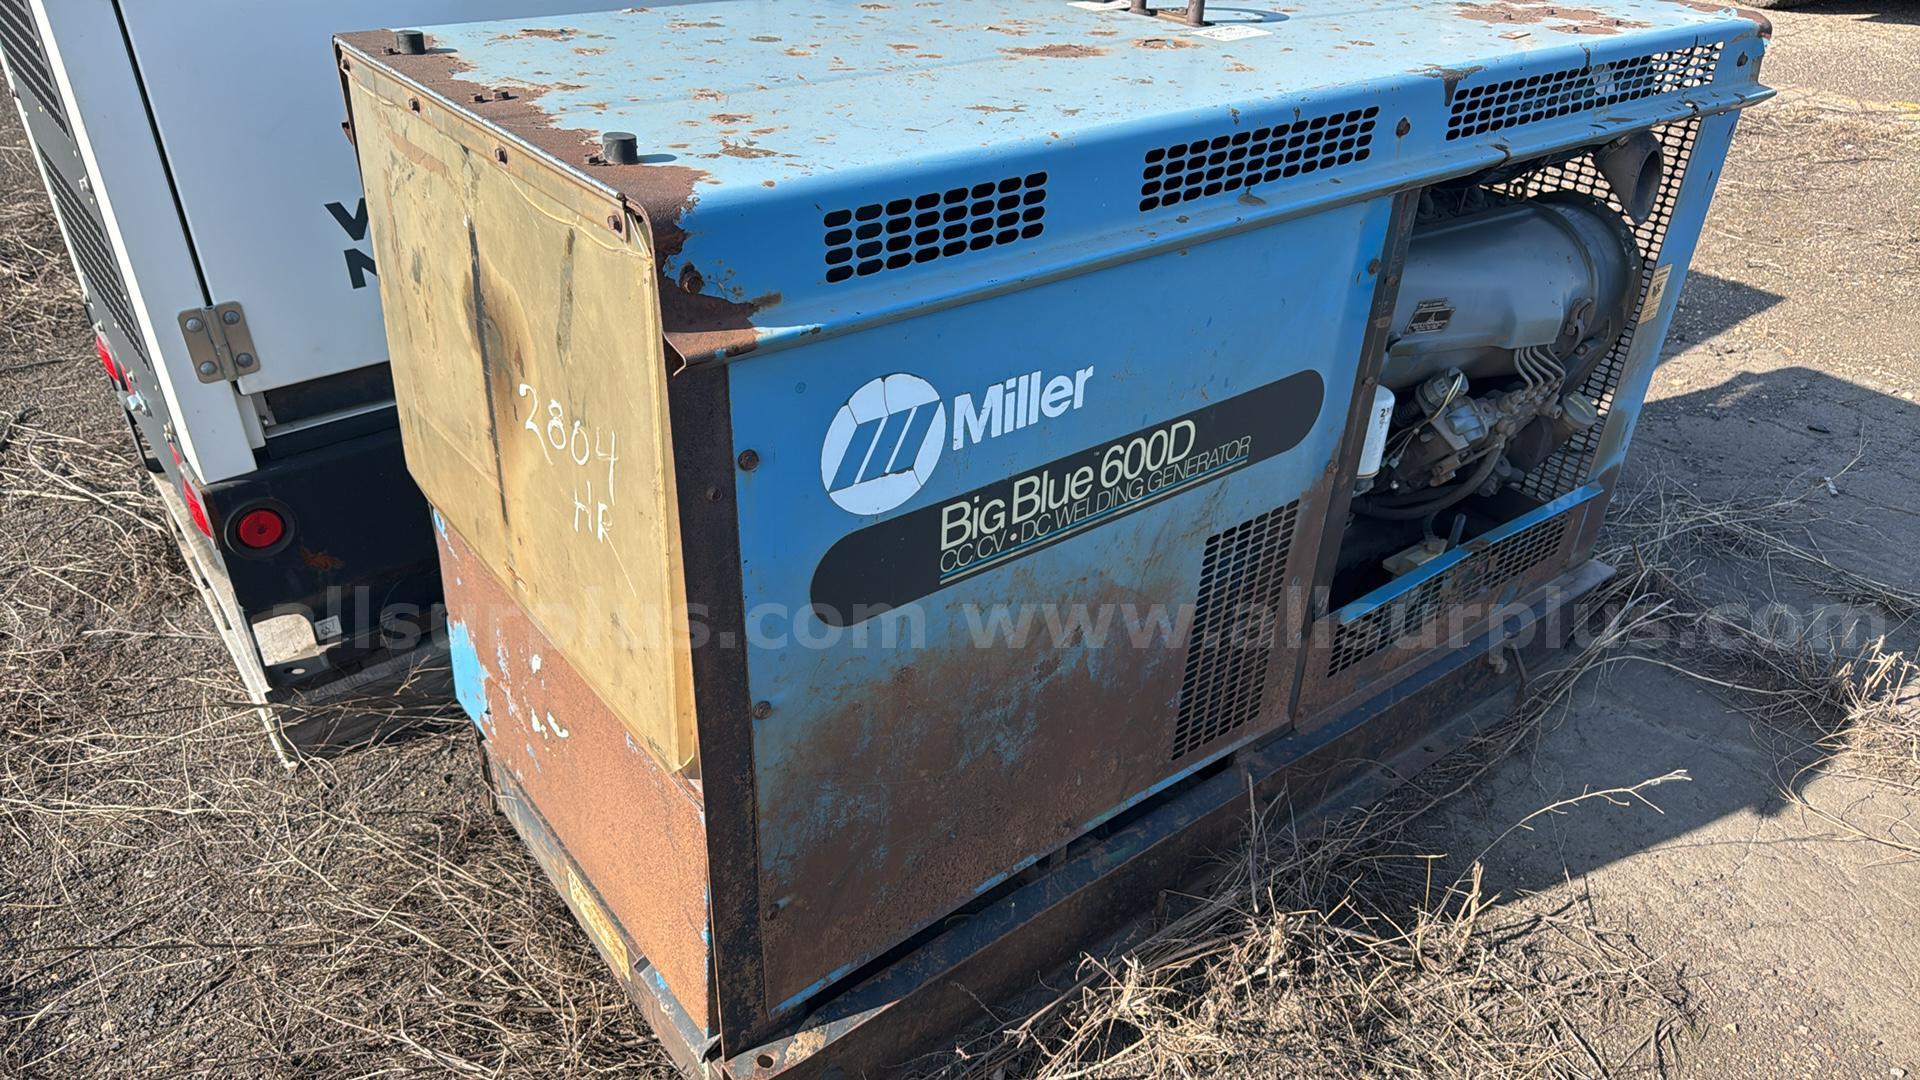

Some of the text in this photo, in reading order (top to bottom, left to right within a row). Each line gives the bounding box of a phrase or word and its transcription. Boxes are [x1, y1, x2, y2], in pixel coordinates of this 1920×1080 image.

[518, 383, 620, 507] 2804
[952, 365, 1094, 451] Miller
[573, 480, 614, 544] HR
[940, 419, 1197, 551] Big Blue 600D
[940, 435, 1252, 575] CC/CV DC WELDING GENERATOR
